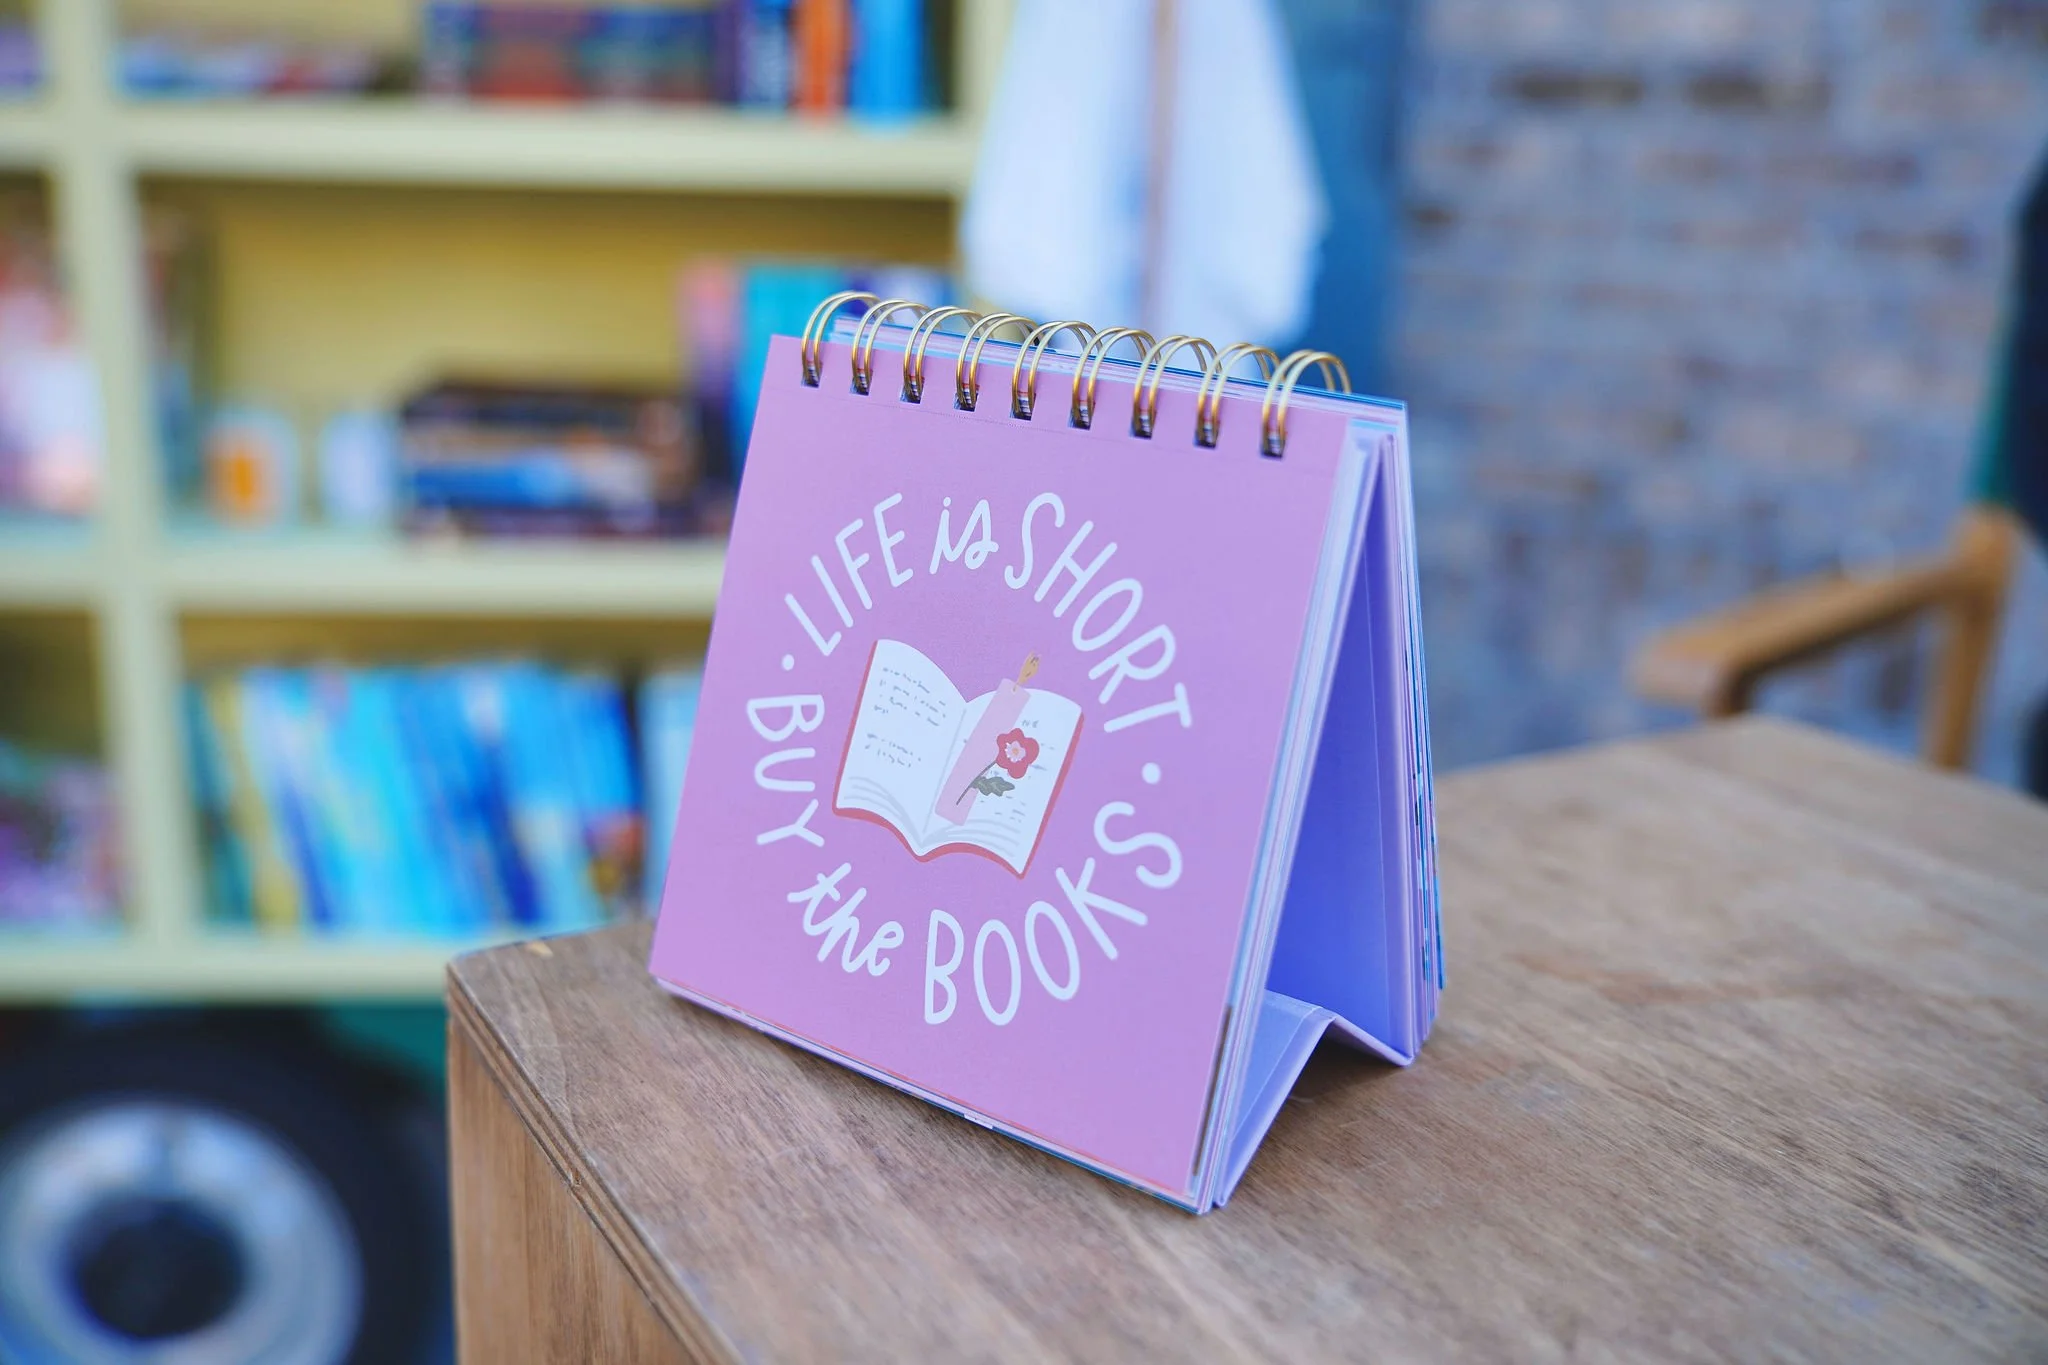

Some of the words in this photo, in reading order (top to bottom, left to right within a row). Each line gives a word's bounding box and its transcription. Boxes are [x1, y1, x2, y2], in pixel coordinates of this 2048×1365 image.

[783, 492, 914, 657] LIFE
[929, 496, 999, 575] is
[1004, 492, 1193, 733] SHORT
[746, 694, 825, 848] BUY
[787, 862, 906, 977] the
[924, 801, 1183, 1026] BOOKS
